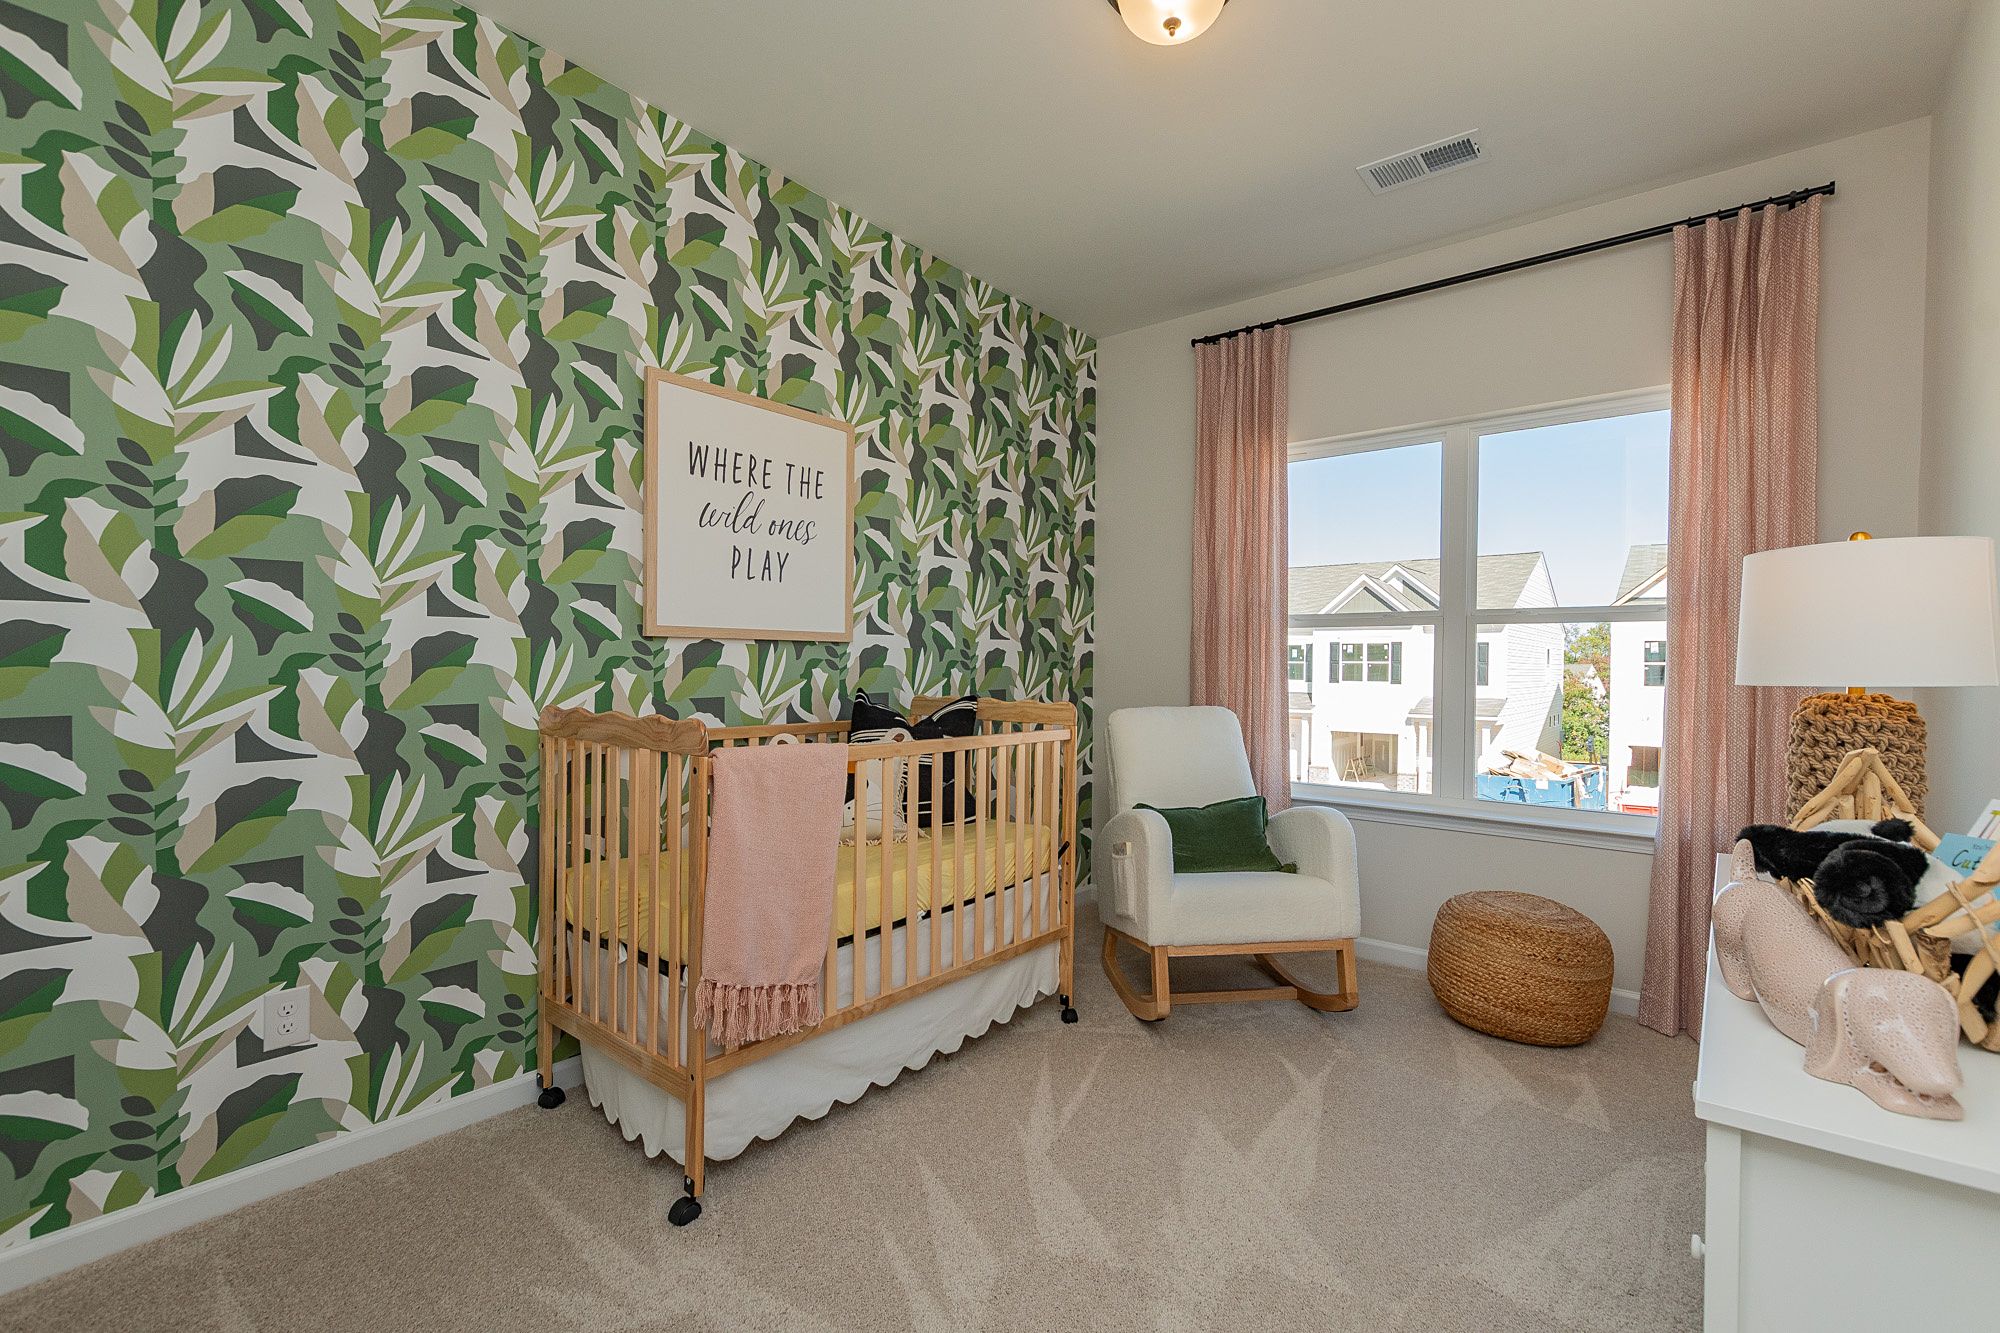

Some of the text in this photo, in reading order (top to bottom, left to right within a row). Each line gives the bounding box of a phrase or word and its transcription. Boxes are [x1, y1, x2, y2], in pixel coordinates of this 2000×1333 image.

[689, 441, 825, 500] WHERE THE
[699, 491, 818, 545] wild ones
[731, 545, 790, 583] PLAY
